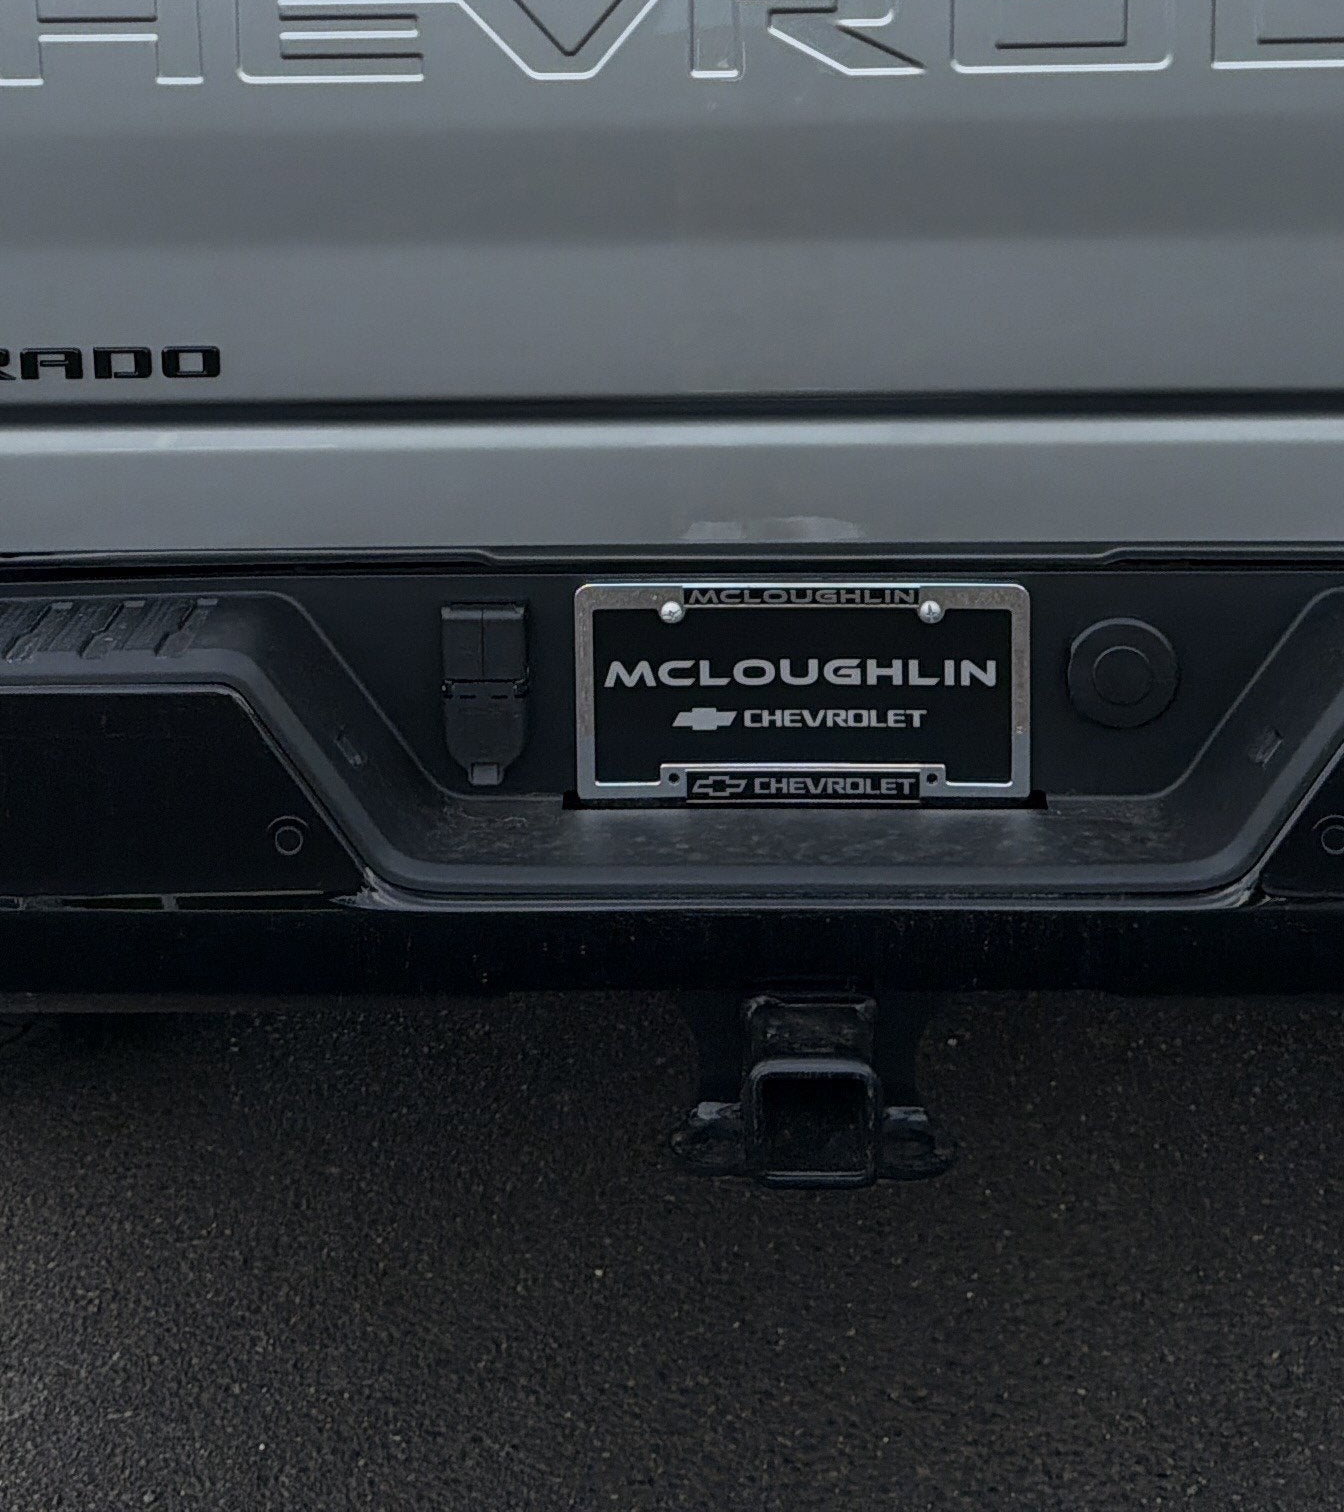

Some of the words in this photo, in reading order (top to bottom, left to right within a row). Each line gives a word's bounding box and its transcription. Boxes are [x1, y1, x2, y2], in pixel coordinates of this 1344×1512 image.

[688, 589, 916, 606] MCLOUGHLIN
[604, 658, 997, 688] MCLOUGHLIN
[743, 709, 928, 729] CHEVROLET
[754, 777, 916, 795] CHEVROLET
